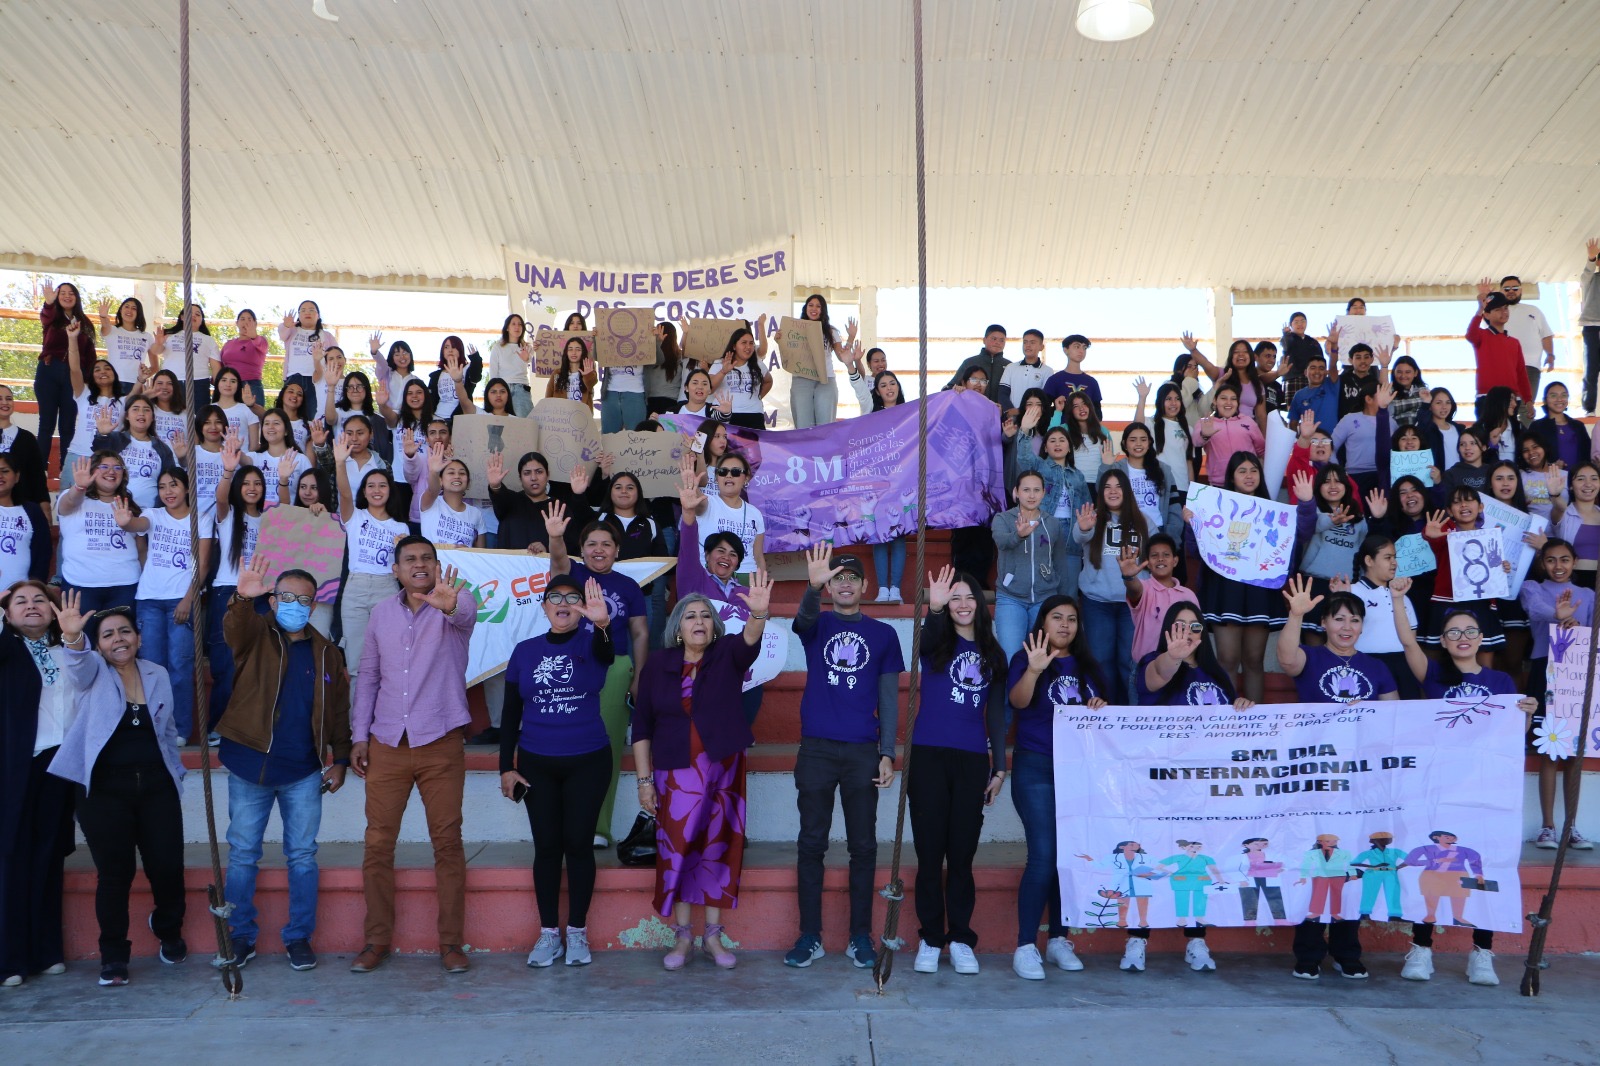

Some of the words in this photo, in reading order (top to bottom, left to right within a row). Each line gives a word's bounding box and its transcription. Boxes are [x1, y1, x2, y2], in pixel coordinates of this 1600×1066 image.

[515, 262, 566, 289] UNA
[579, 271, 663, 294] MUJER
[673, 264, 738, 292] DEBE
[744, 251, 786, 280] SER
[653, 297, 744, 321] COSAS:
[628, 432, 650, 444] Ser
[849, 434, 883, 448] Somos
[887, 428, 896, 438] el
[941, 427, 963, 450] UNA
[849, 447, 873, 461] grito
[875, 443, 886, 452] de
[890, 438, 905, 447] las
[948, 431, 977, 468] MENOS
[871, 455, 884, 468] ya
[887, 451, 900, 460] no
[885, 463, 903, 474] voz
[755, 474, 781, 487] SOLA
[446, 523, 454, 531] FUE
[9, 531, 23, 540] HORA
[369, 531, 377, 539] FUE
[444, 530, 453, 539] FUE
[366, 539, 375, 548] FUE
[1324, 536, 1354, 549] adidas
[775, 556, 791, 566] SIN
[1207, 552, 1237, 575] Marzo
[1399, 559, 1427, 572] LUCHA
[549, 692, 587, 703] Internacional
[557, 703, 578, 714] Mujer
[1323, 708, 1376, 718] CUENTA
[1285, 719, 1330, 728] CAPAZ
[1232, 749, 1277, 761] 8M
[1289, 744, 1337, 760] DIA
[1150, 760, 1372, 780] INTERNACIONAL
[1382, 756, 1416, 769] DE
[1210, 784, 1244, 796] LA
[1255, 779, 1350, 796] MUJER
